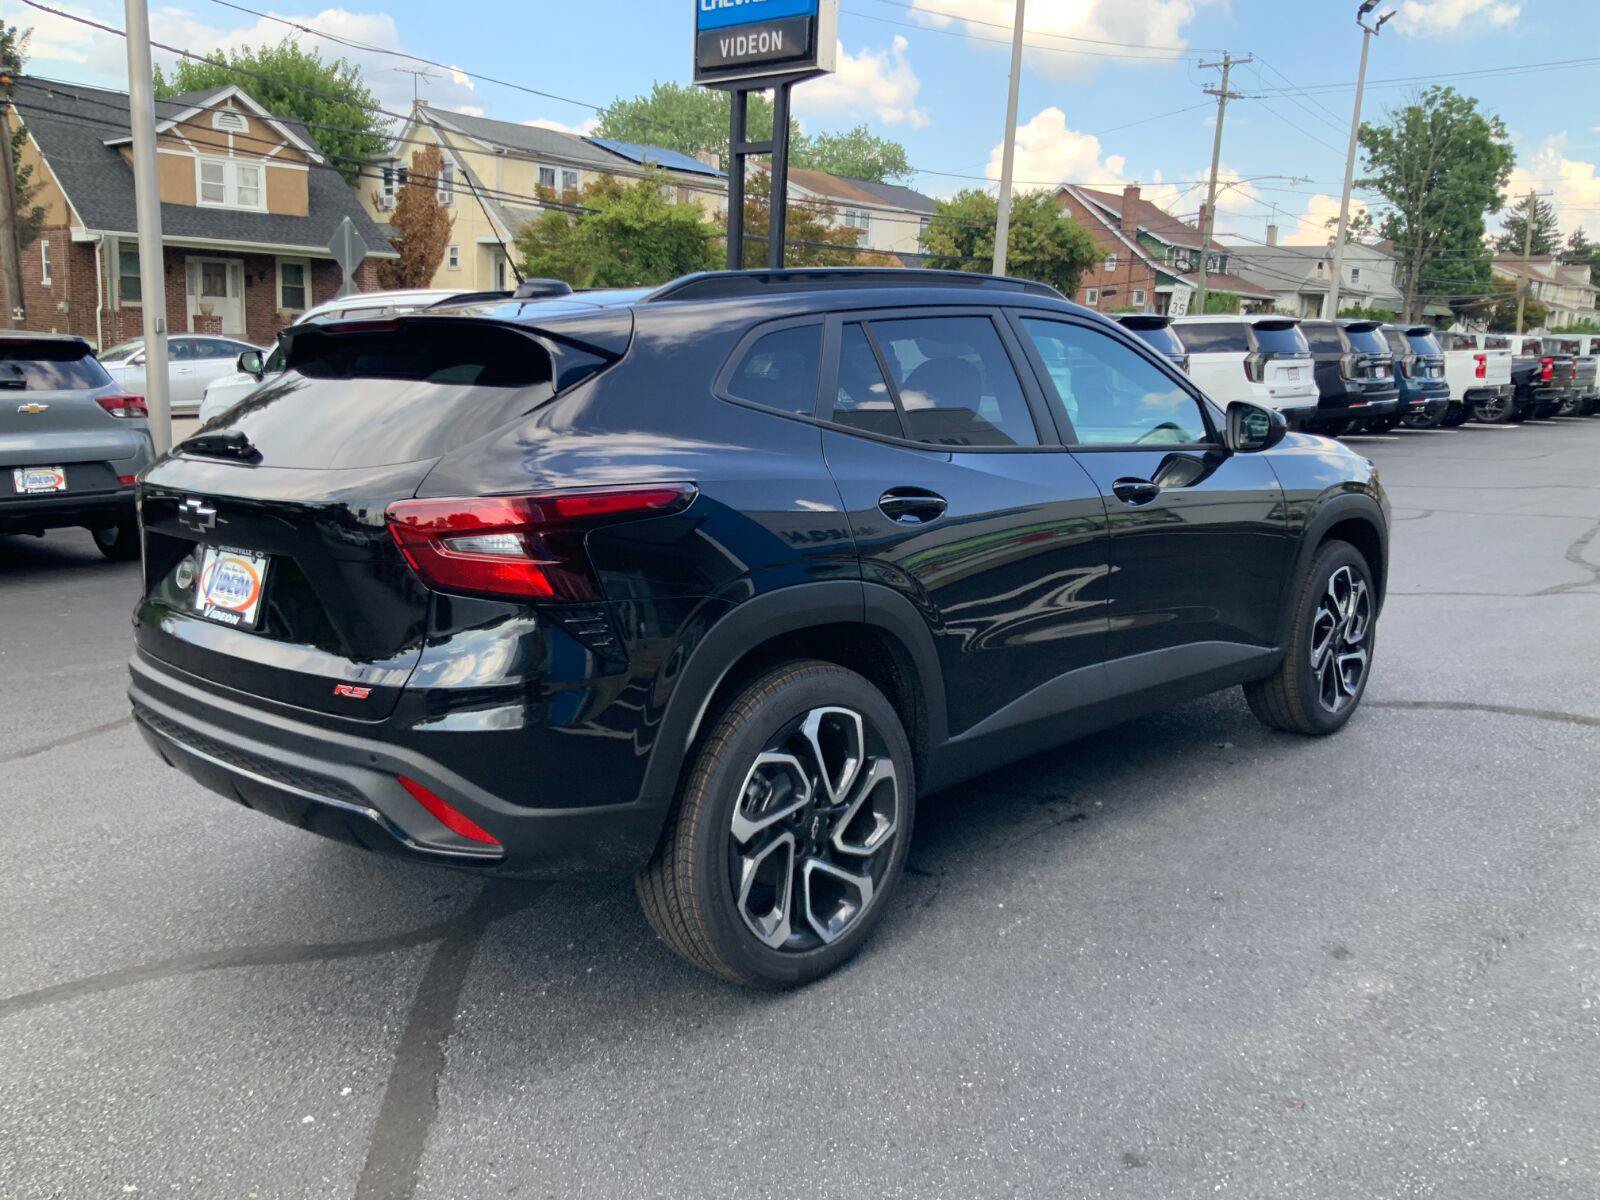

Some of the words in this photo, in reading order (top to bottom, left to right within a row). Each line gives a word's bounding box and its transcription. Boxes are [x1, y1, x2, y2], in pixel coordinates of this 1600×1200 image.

[720, 30, 783, 58] VIDEON
[1171, 302, 1185, 316] 35
[334, 684, 373, 699] RS
